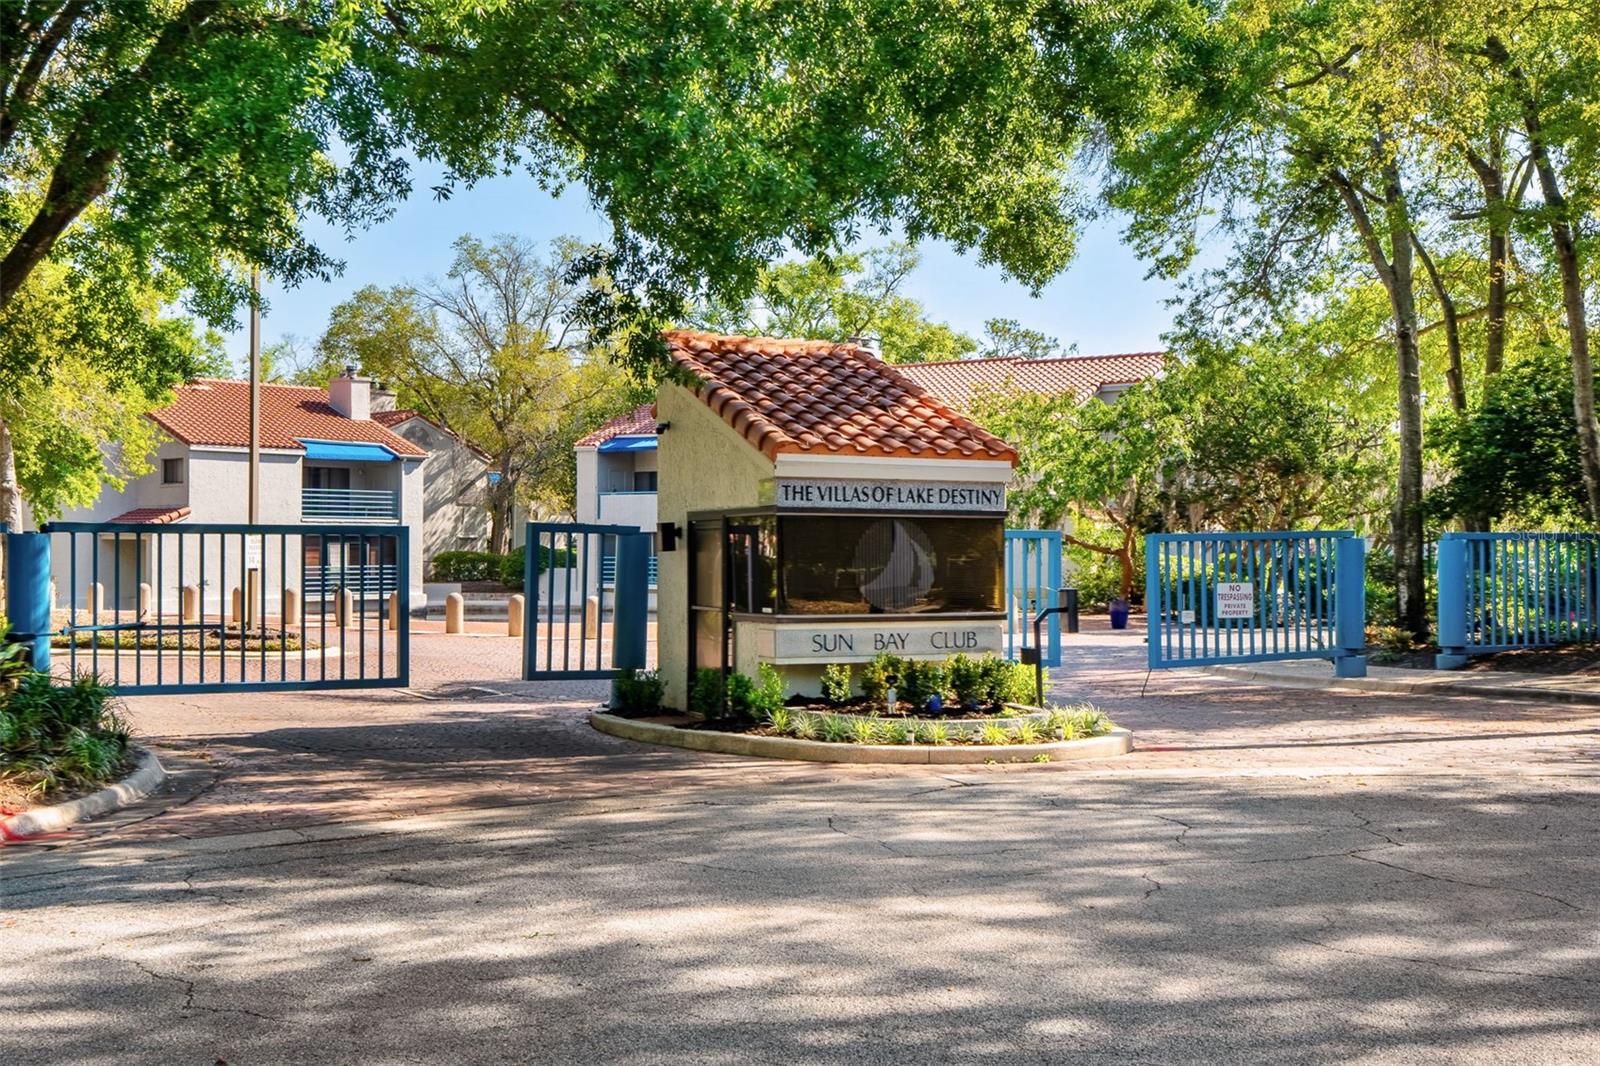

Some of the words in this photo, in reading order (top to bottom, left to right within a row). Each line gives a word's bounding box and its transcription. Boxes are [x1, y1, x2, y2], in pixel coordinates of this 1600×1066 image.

[782, 484, 813, 501] THE
[817, 486, 869, 503] VILLAS
[872, 486, 893, 503] OF
[898, 487, 934, 504] LAKE
[938, 488, 1002, 505] DESTINY
[1229, 584, 1241, 592] NO
[1218, 593, 1252, 601] TRESPASSING
[812, 633, 854, 653] SUN
[874, 632, 910, 651] BAY
[930, 630, 978, 650] CLUB
